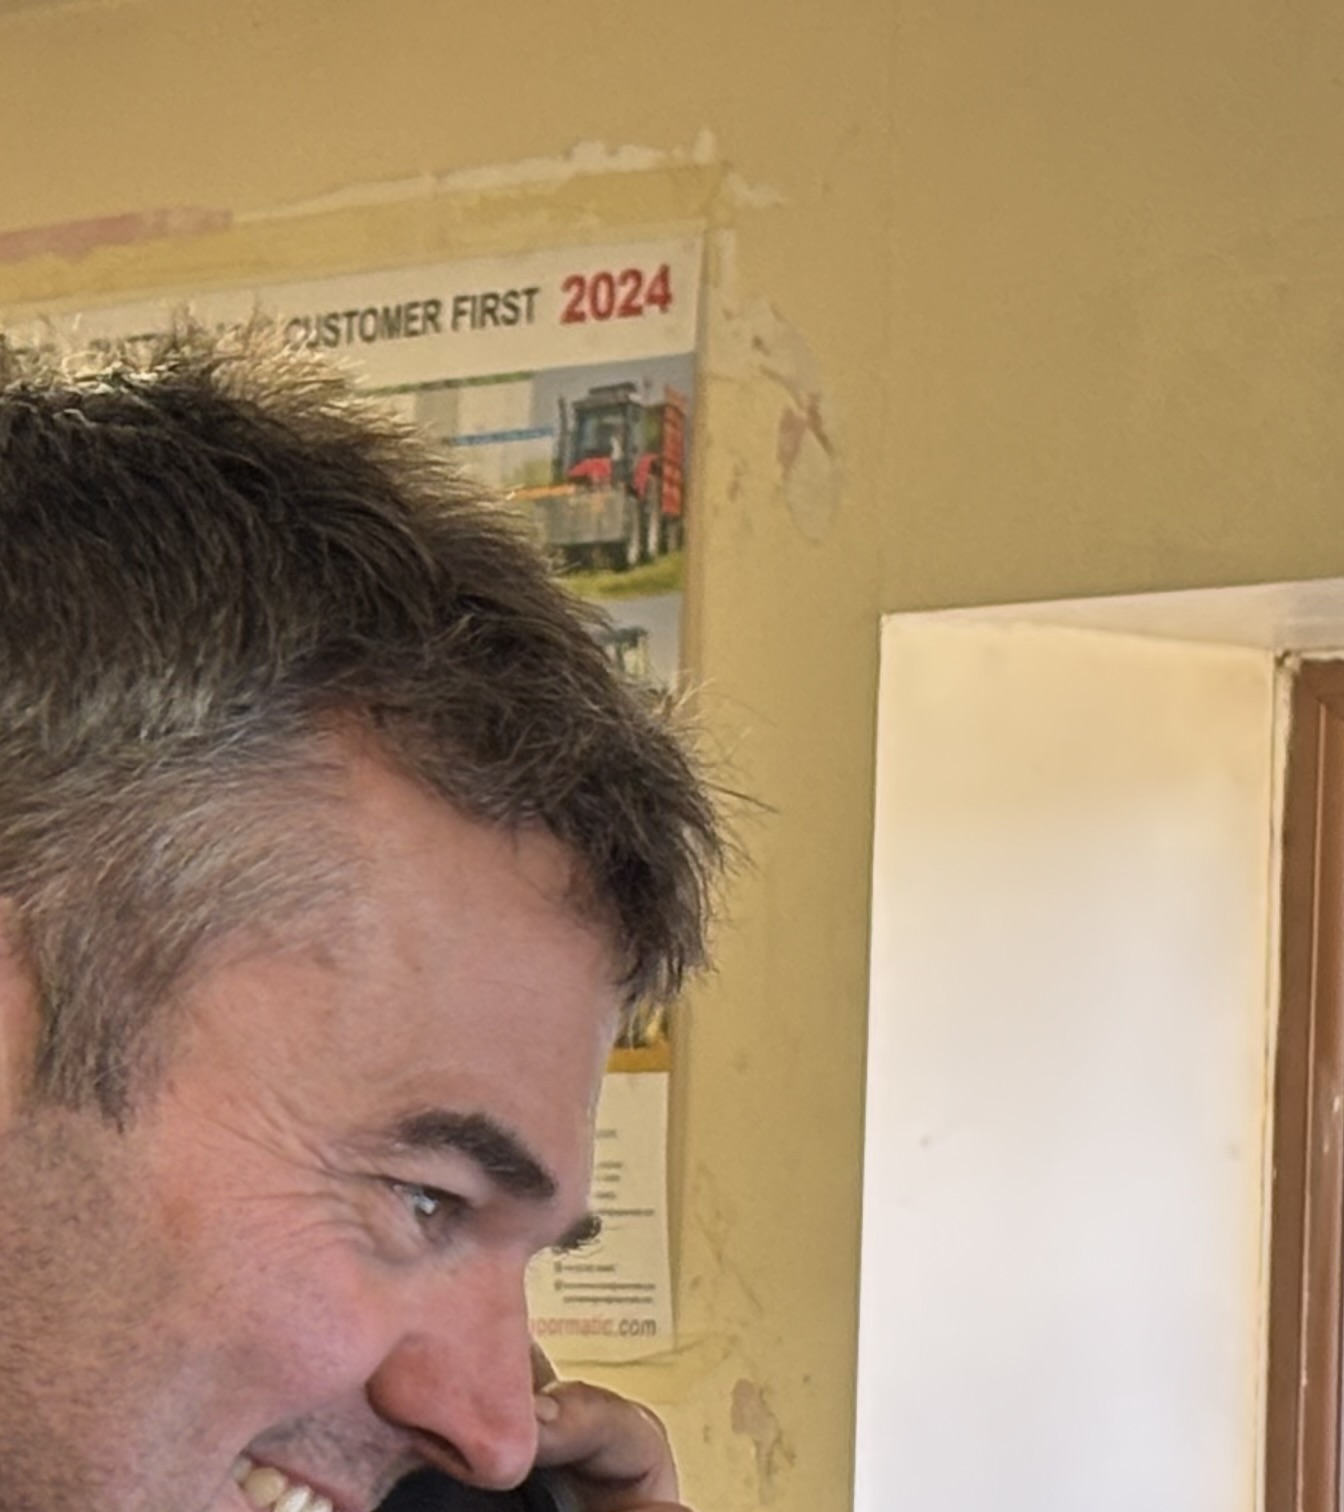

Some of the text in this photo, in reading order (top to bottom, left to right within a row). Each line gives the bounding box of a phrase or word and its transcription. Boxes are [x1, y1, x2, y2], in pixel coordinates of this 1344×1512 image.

[287, 264, 674, 350] CUSTOMER FIRST 2024
[530, 1316, 657, 1338] pormatic.com
